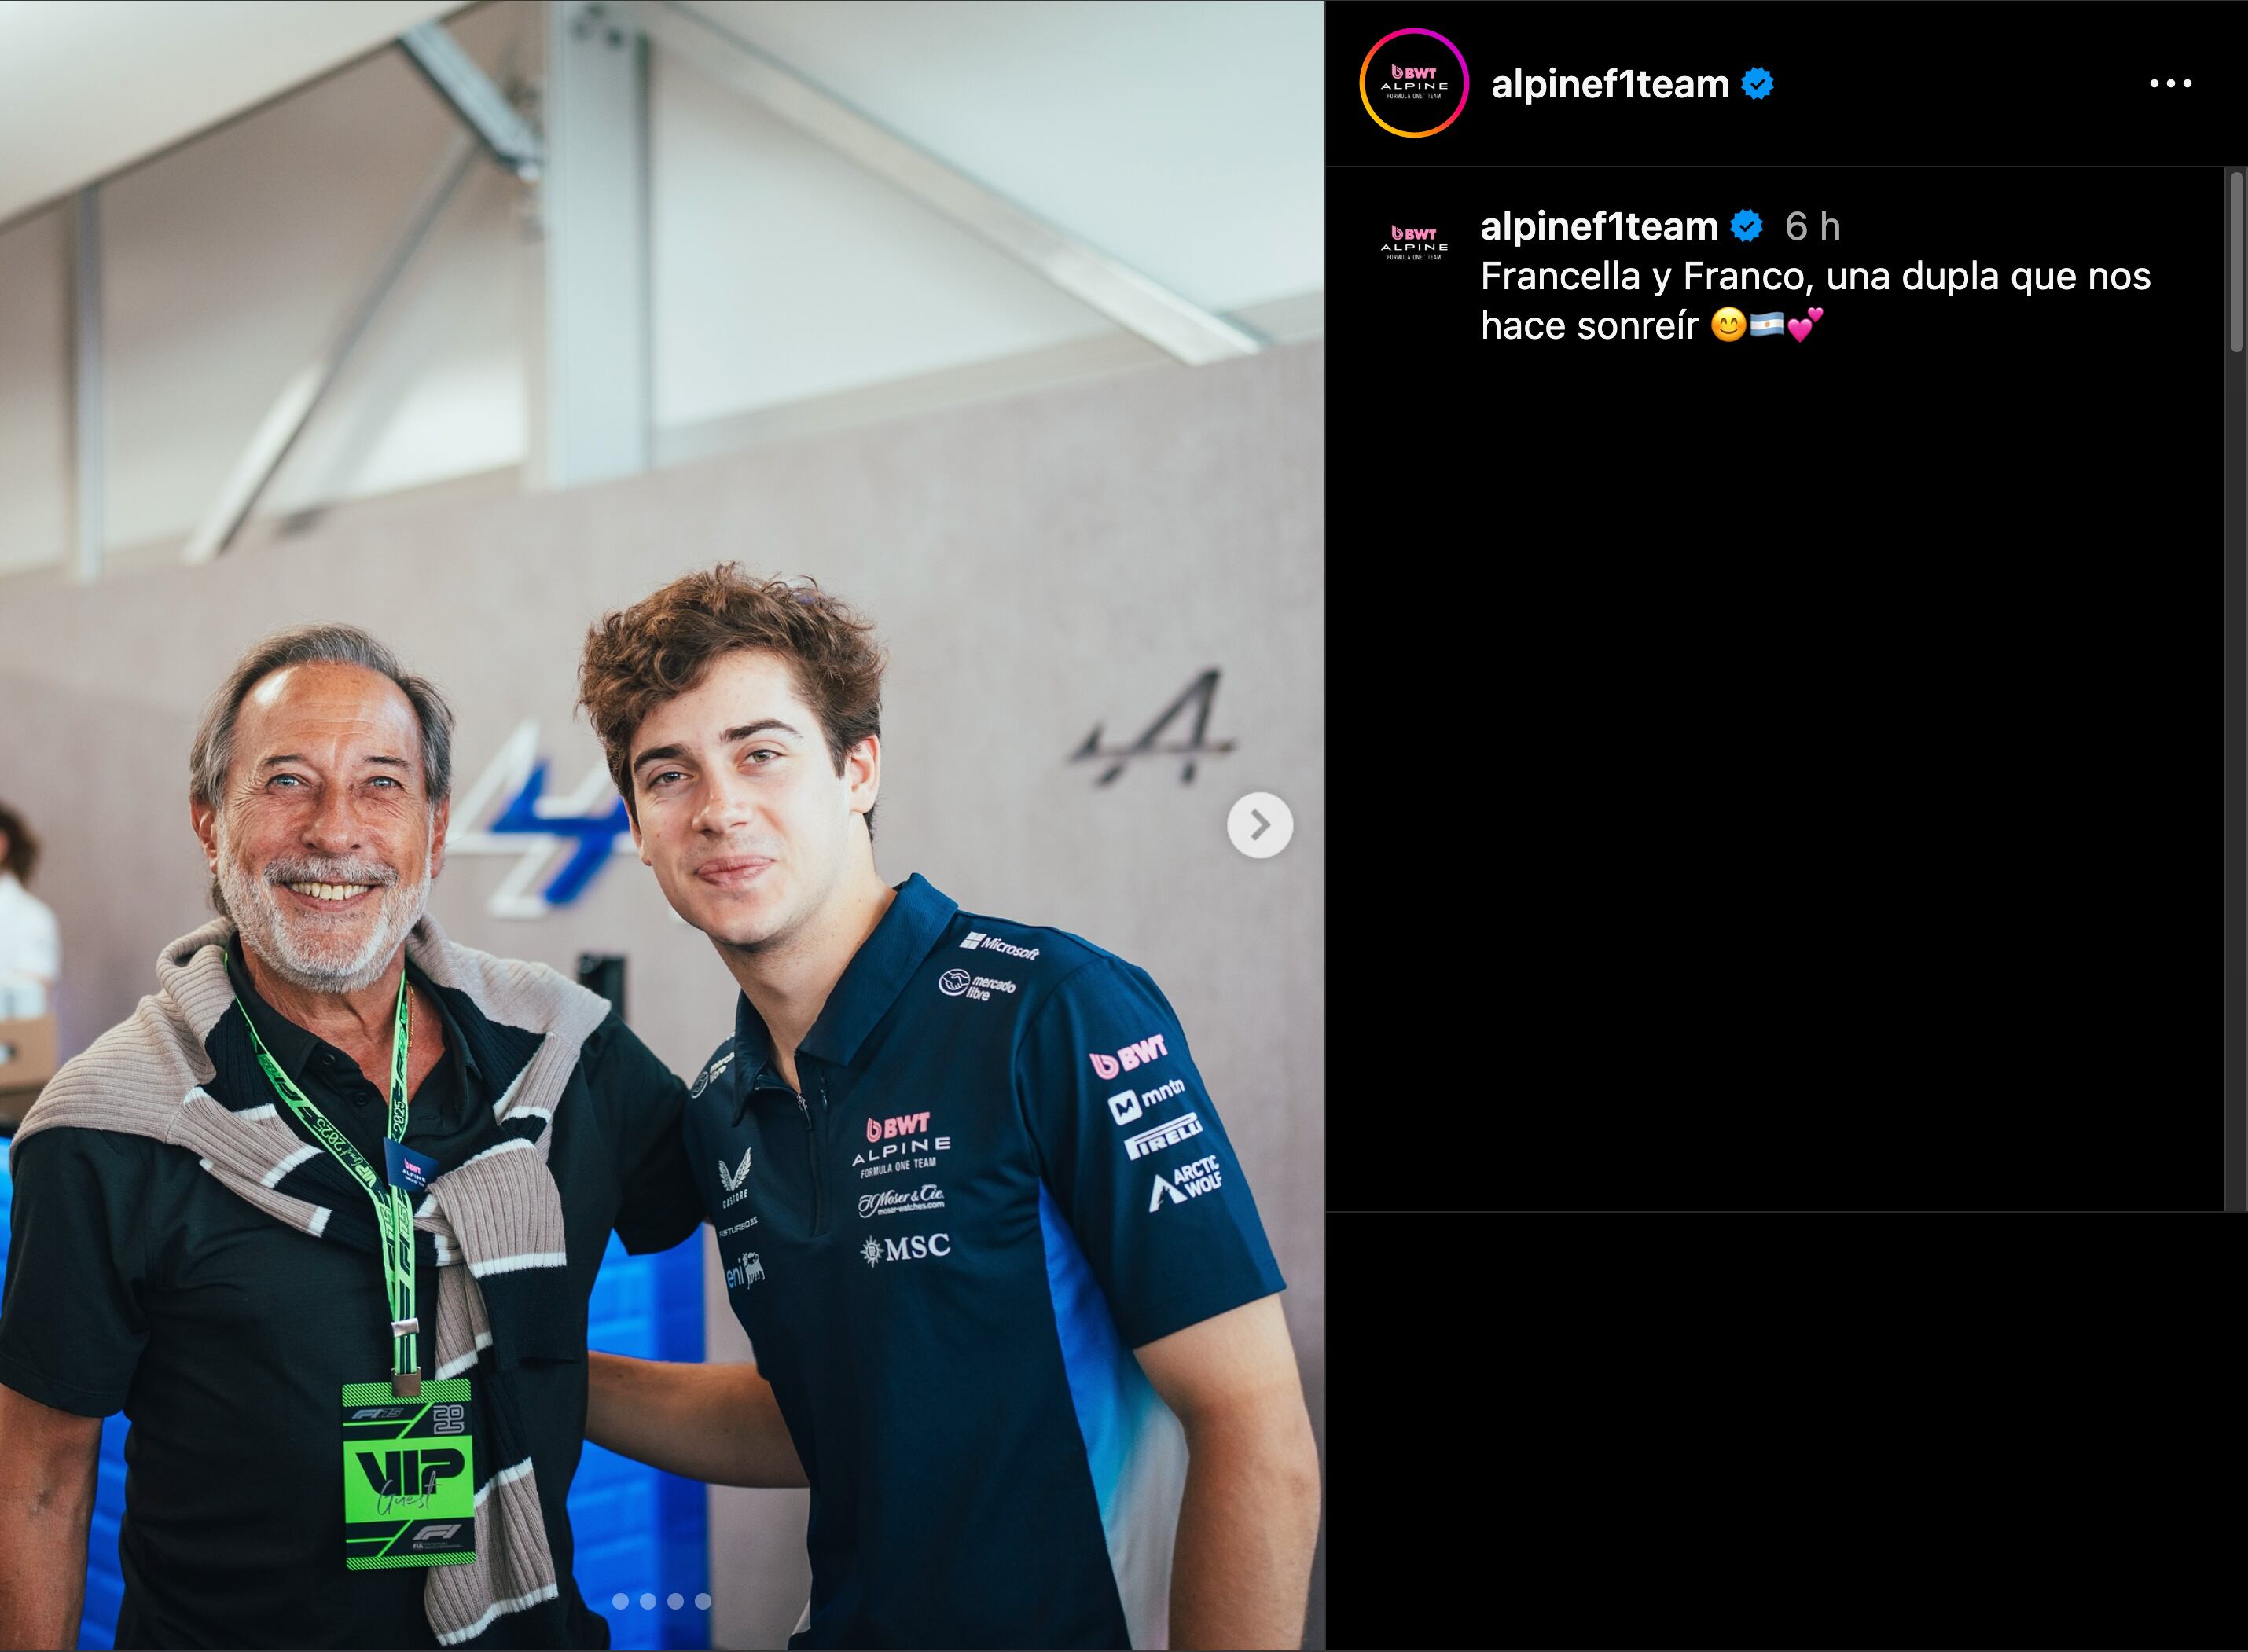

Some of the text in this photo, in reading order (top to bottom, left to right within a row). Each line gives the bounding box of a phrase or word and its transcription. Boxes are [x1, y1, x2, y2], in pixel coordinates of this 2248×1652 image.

[981, 937, 1040, 960] Microsoft
[966, 986, 990, 1001] libre
[972, 976, 1016, 993] mercado
[1117, 1033, 1168, 1072] BWT
[1141, 1078, 1185, 1107] mntn
[393, 1098, 405, 1133] 2025
[884, 1111, 931, 1139] BWT
[312, 1118, 347, 1151] 2025
[852, 1136, 951, 1166] ALPINE
[861, 1157, 936, 1179] FORMULA ONE TEAM
[1174, 1155, 1219, 1185] ARCTIC
[722, 1188, 748, 1209] CASTORE
[1185, 1171, 1222, 1199] WOLF
[884, 1233, 951, 1261] MSC
[727, 1257, 744, 1288] eni
[355, 1448, 465, 1496] VIP
[377, 1470, 443, 1516] Guest
